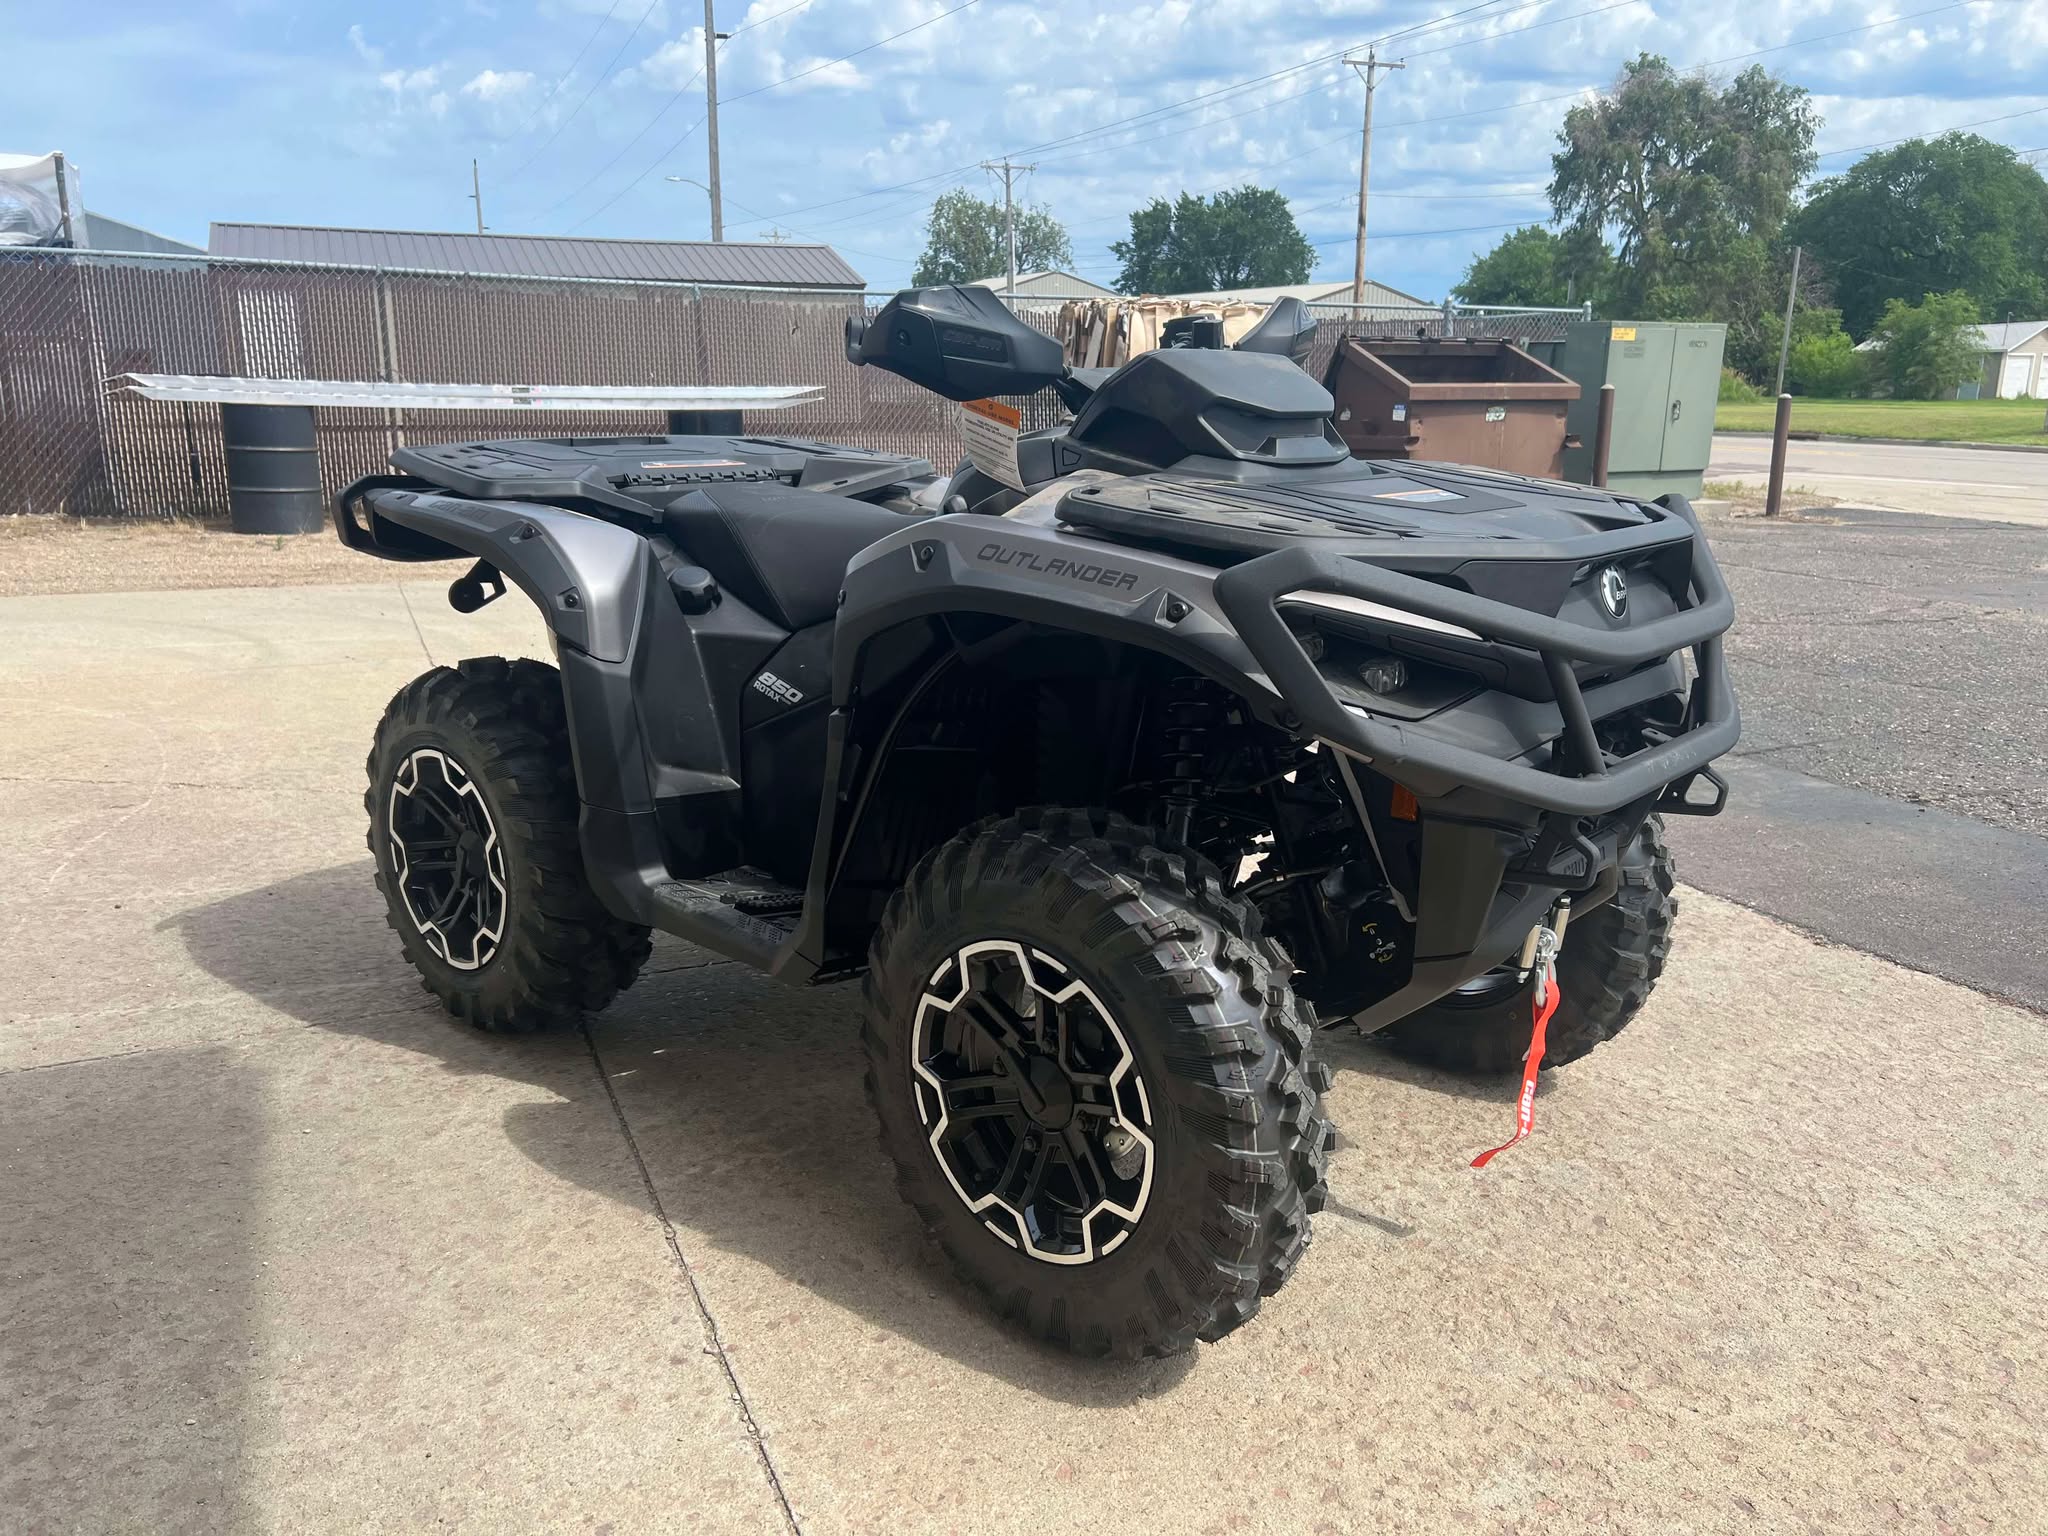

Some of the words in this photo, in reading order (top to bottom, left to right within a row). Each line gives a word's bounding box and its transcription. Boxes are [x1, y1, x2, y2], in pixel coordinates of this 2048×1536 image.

[977, 543, 1139, 591] OUTLANDER
[753, 680, 781, 702] ROTAX
[758, 671, 804, 703] 850
